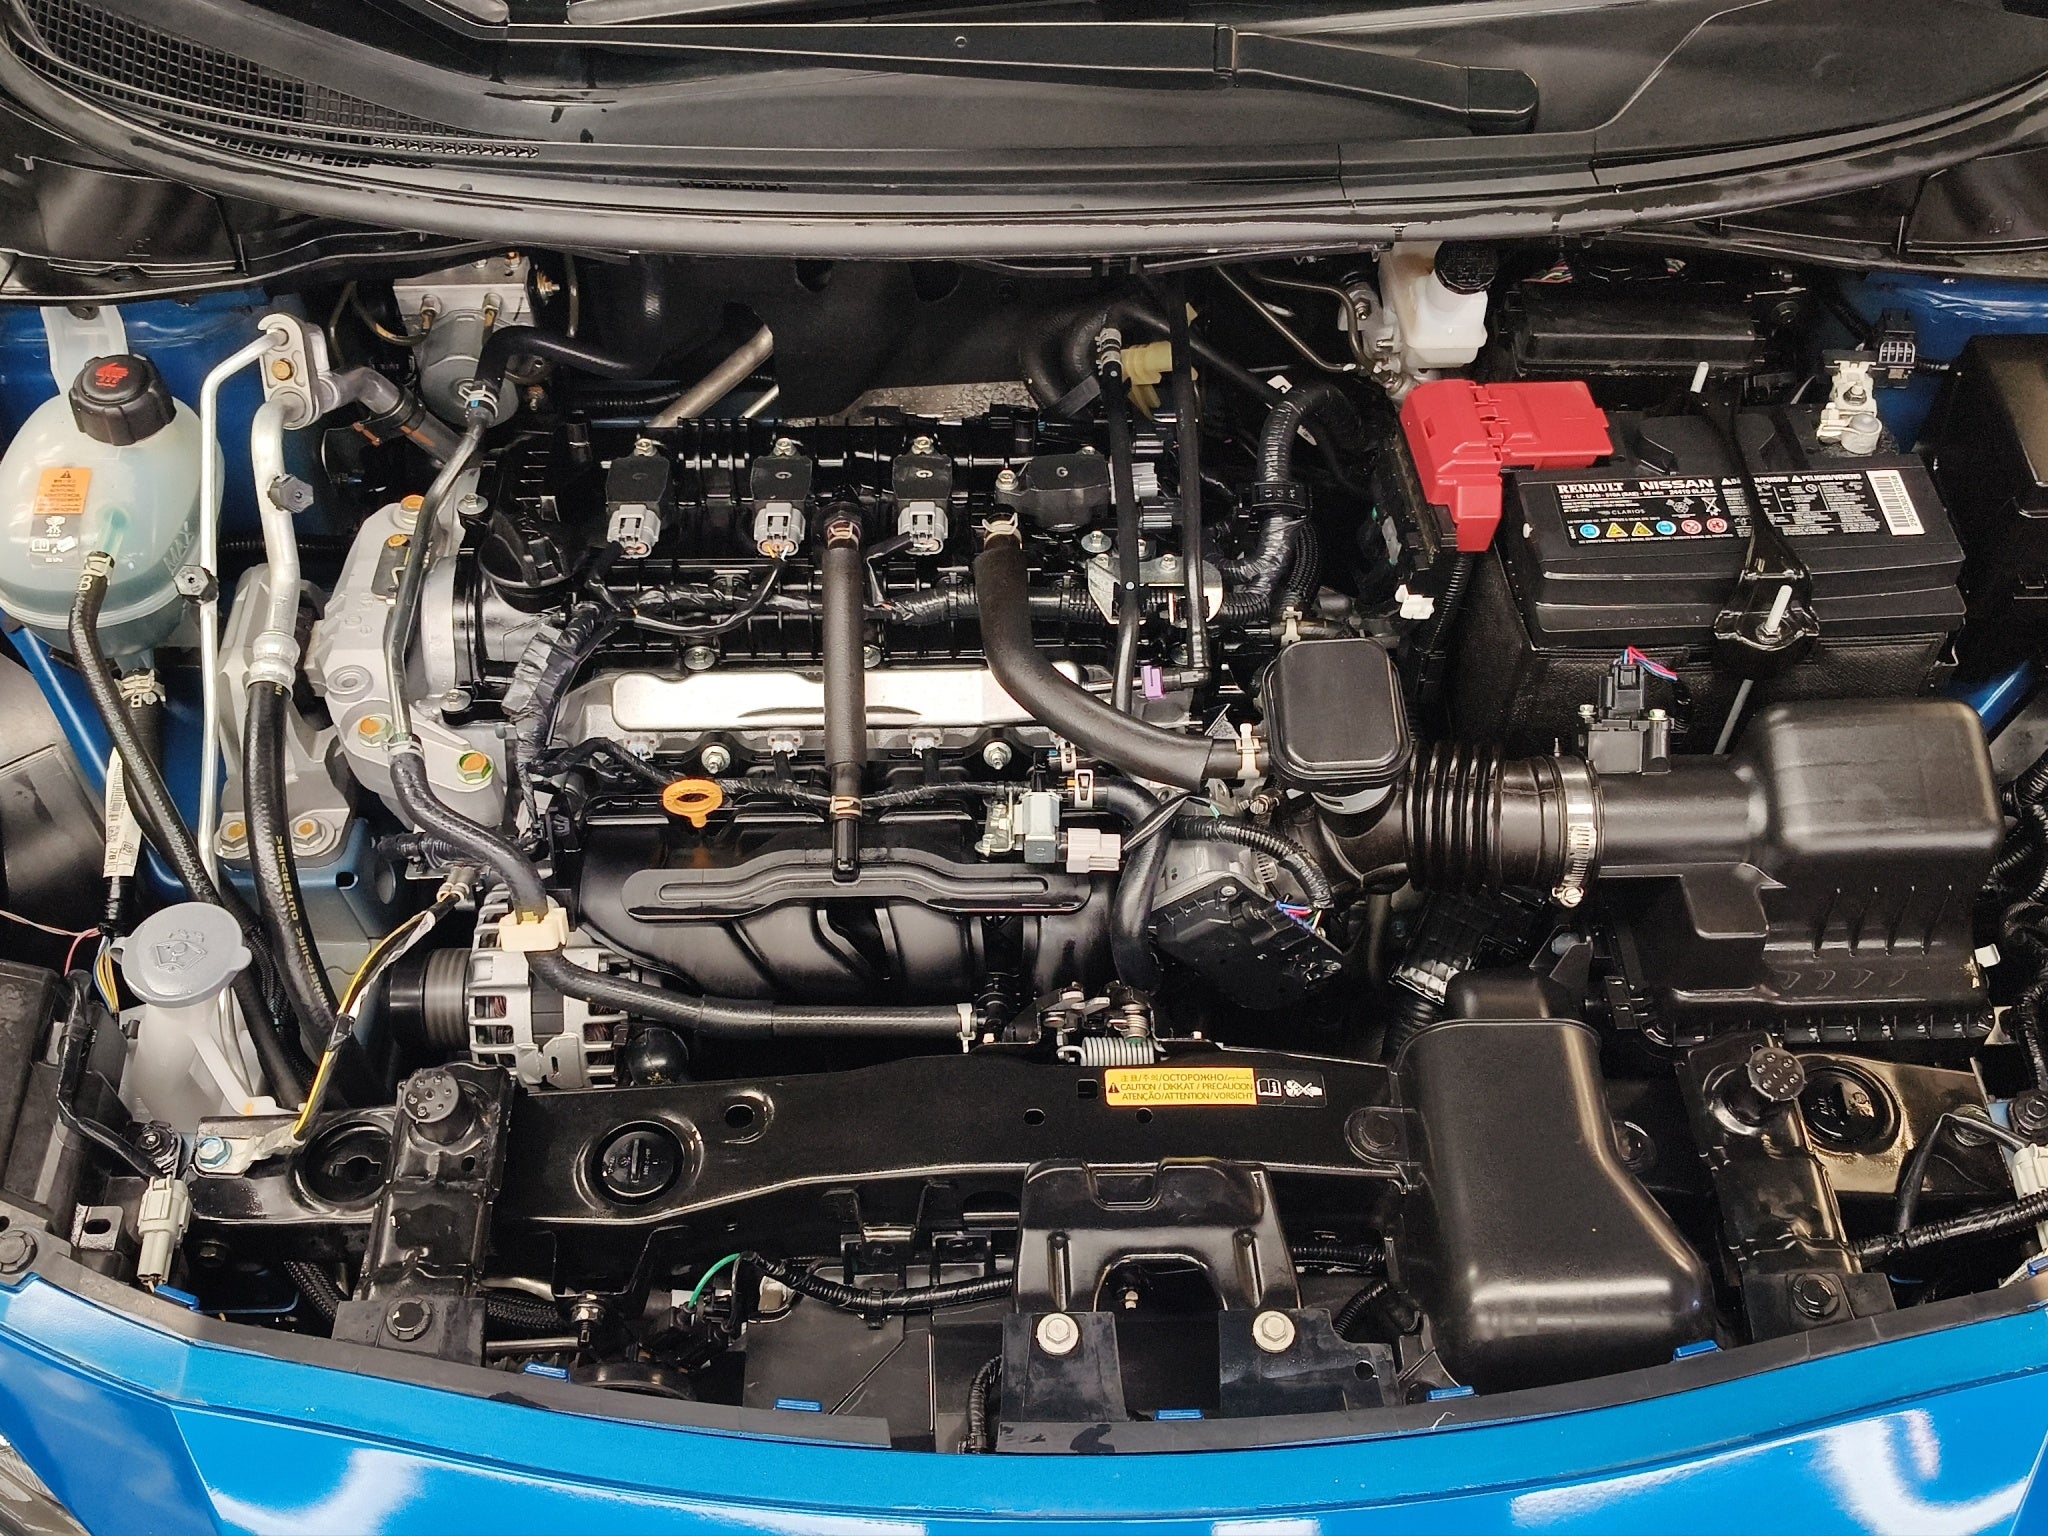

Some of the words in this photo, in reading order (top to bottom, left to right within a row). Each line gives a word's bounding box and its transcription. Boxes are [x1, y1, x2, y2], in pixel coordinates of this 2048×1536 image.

[1557, 482, 1624, 494] RENAULT
[1638, 479, 1715, 490] NISSAN
[1611, 508, 1646, 516] CLARIOS
[78, 575, 94, 591] B
[1120, 1083, 1156, 1091] CAUTION
